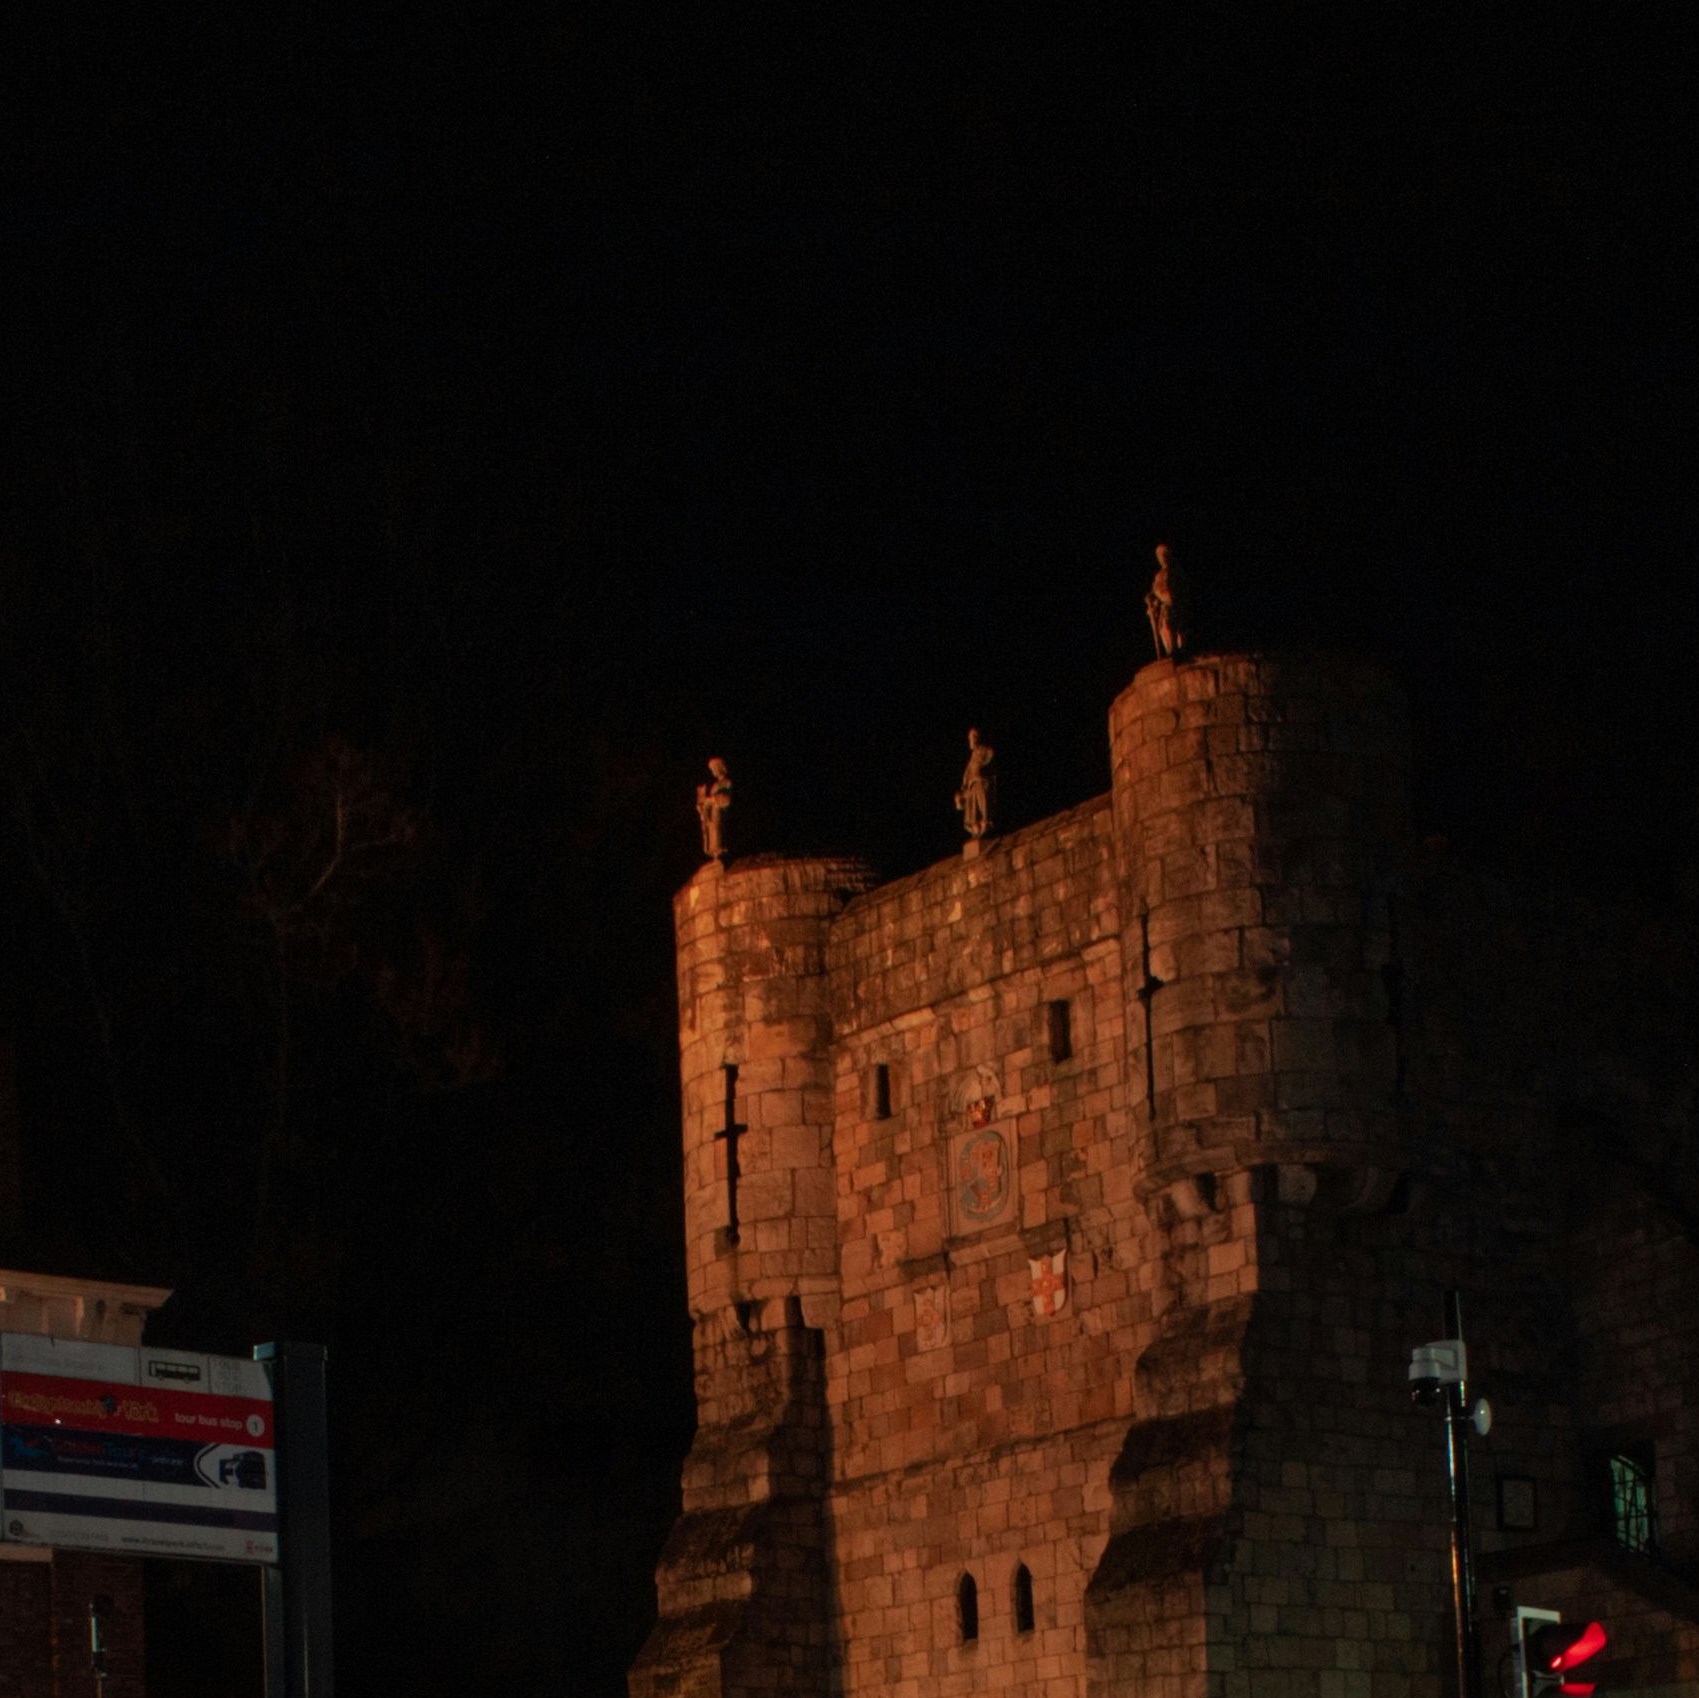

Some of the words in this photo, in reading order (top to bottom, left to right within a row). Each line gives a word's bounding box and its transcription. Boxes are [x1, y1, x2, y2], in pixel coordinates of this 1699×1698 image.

[174, 1412, 197, 1425] tour
[199, 1414, 218, 1427] bus
[220, 1416, 243, 1431] stop
